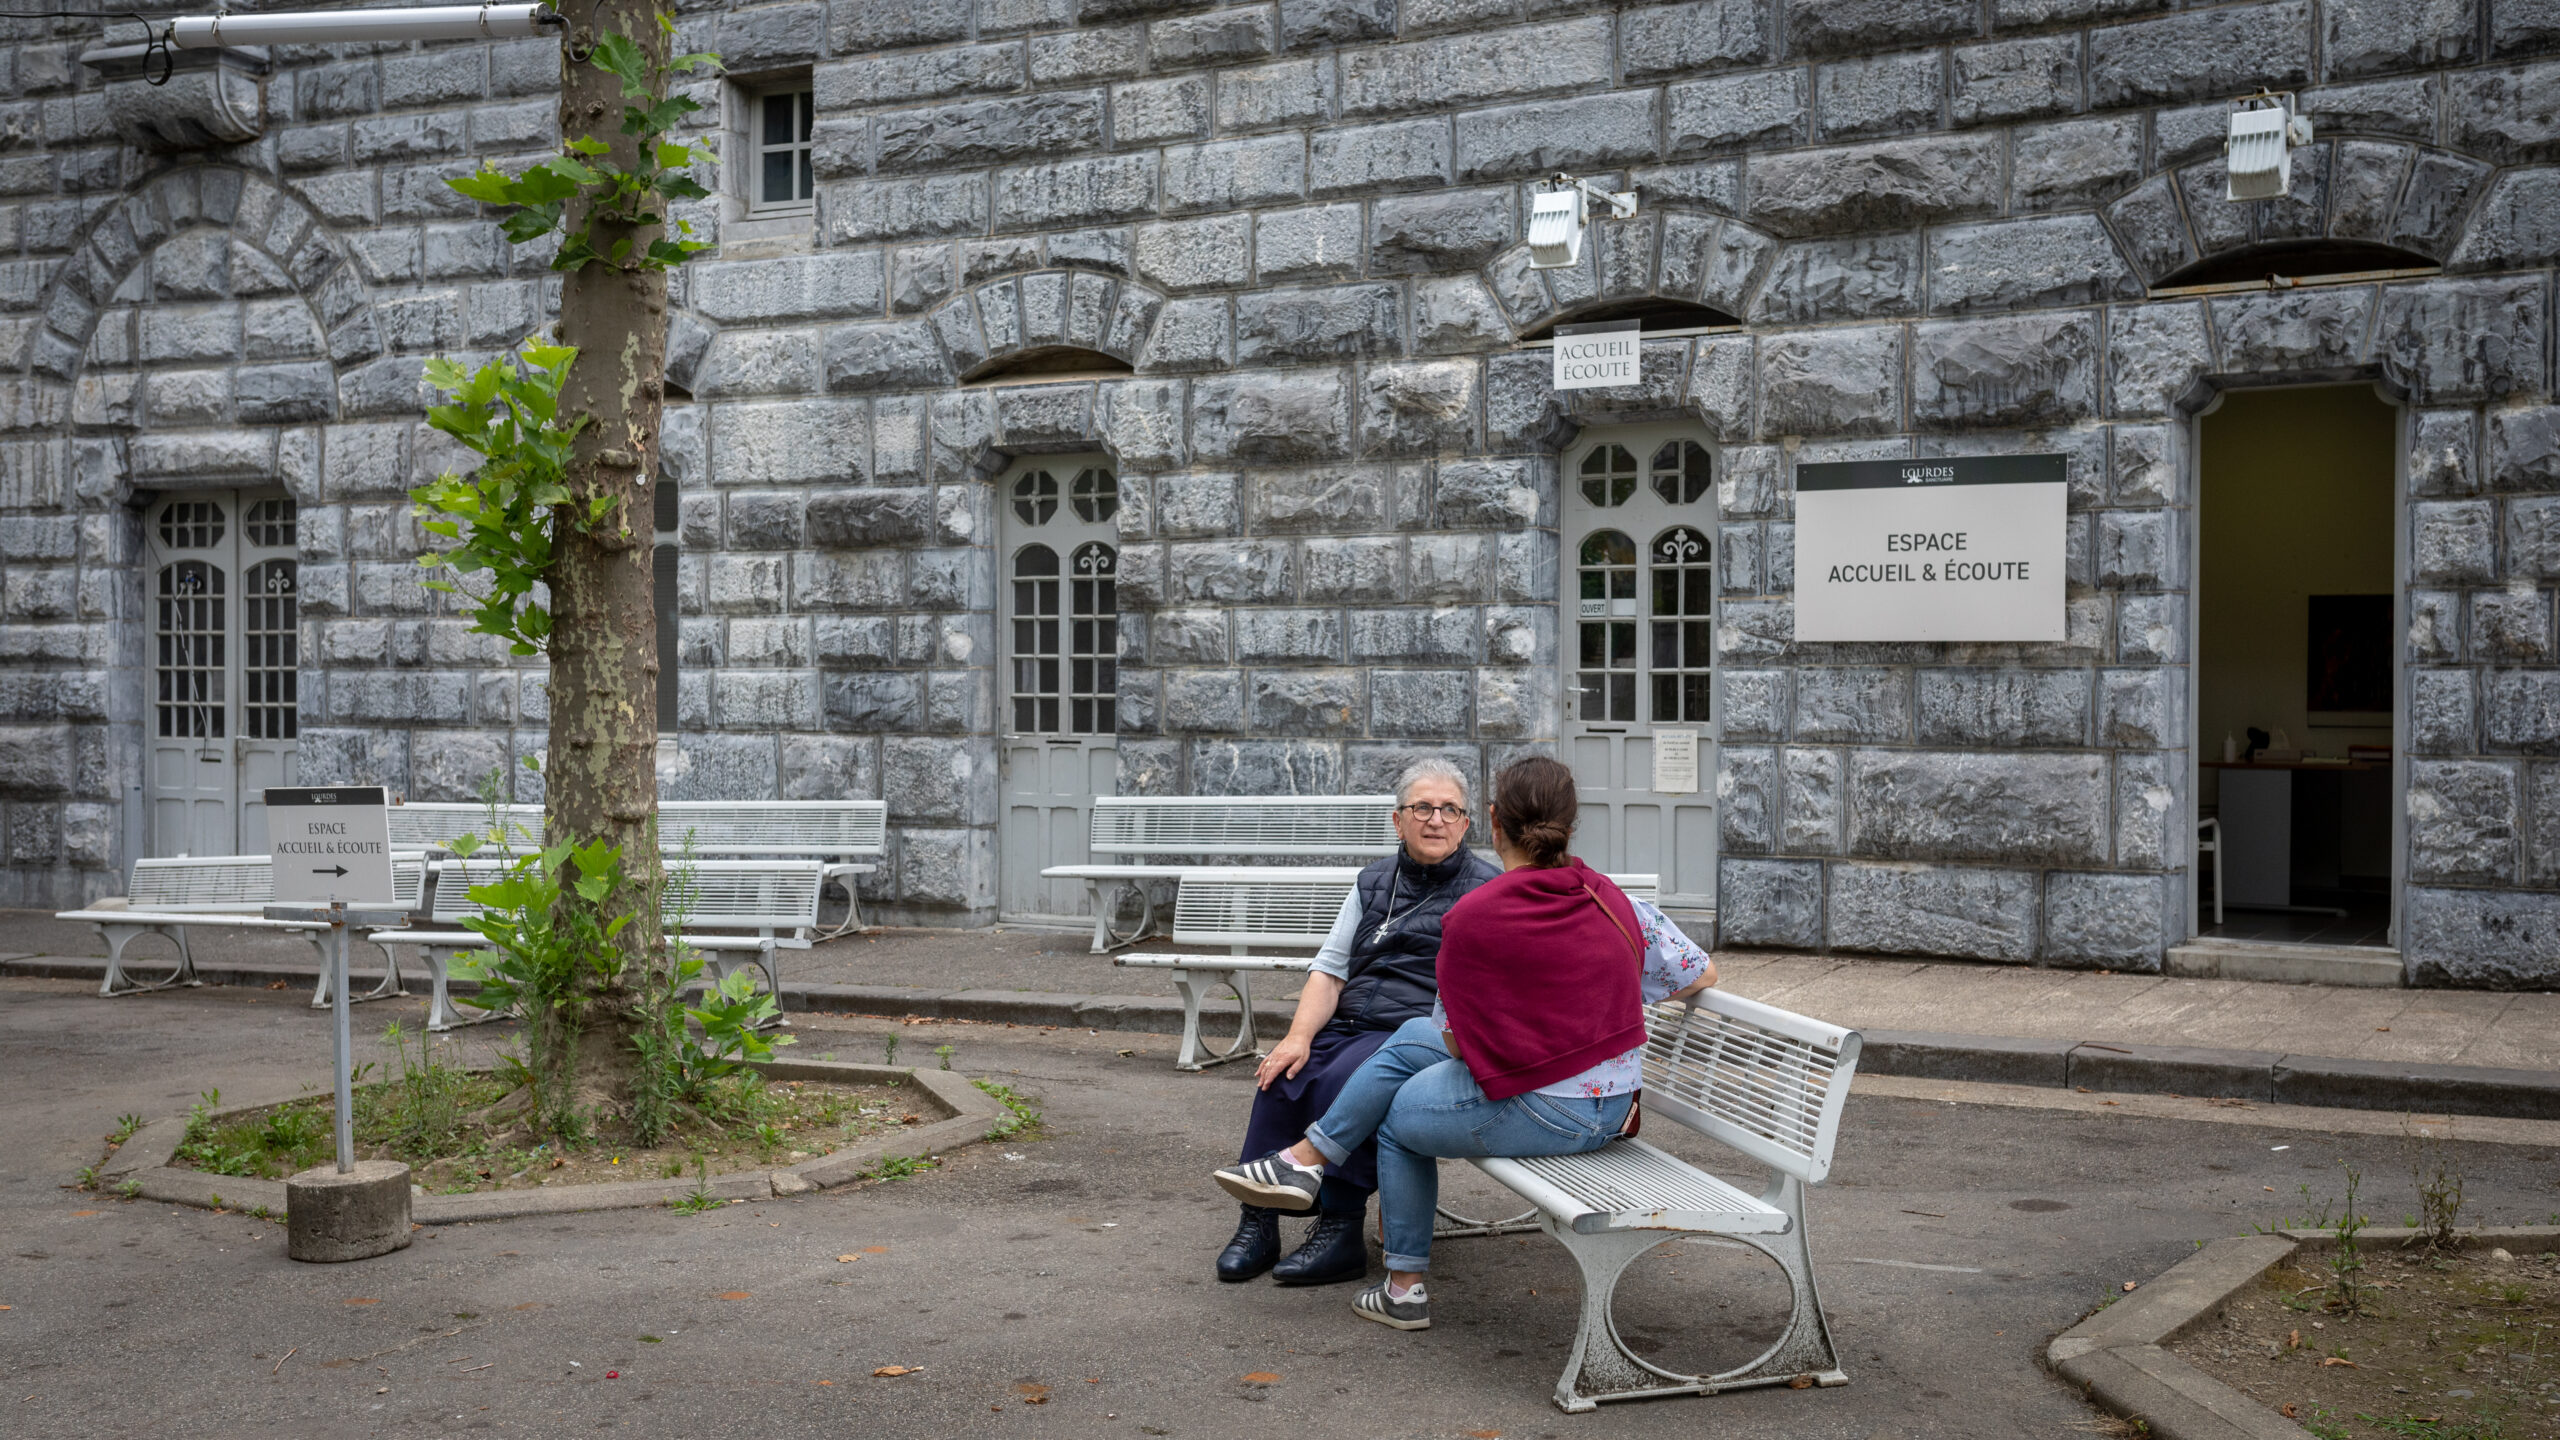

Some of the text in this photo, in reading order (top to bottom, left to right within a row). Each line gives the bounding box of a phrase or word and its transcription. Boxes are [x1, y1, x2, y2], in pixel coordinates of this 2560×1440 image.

[1560, 341, 1633, 360] ACCUEIL
[1563, 362, 1630, 380] ÉCOUTE
[1902, 466, 1954, 479] LOURDES
[1887, 532, 1967, 552] ESPACE
[1828, 558, 2029, 583] ACCUEIL & ÉCOUTE
[1581, 603, 1605, 614] OUVERT
[308, 822, 346, 835] ESPACE
[277, 839, 382, 854] ACCUEIL & ÉCOUTE
